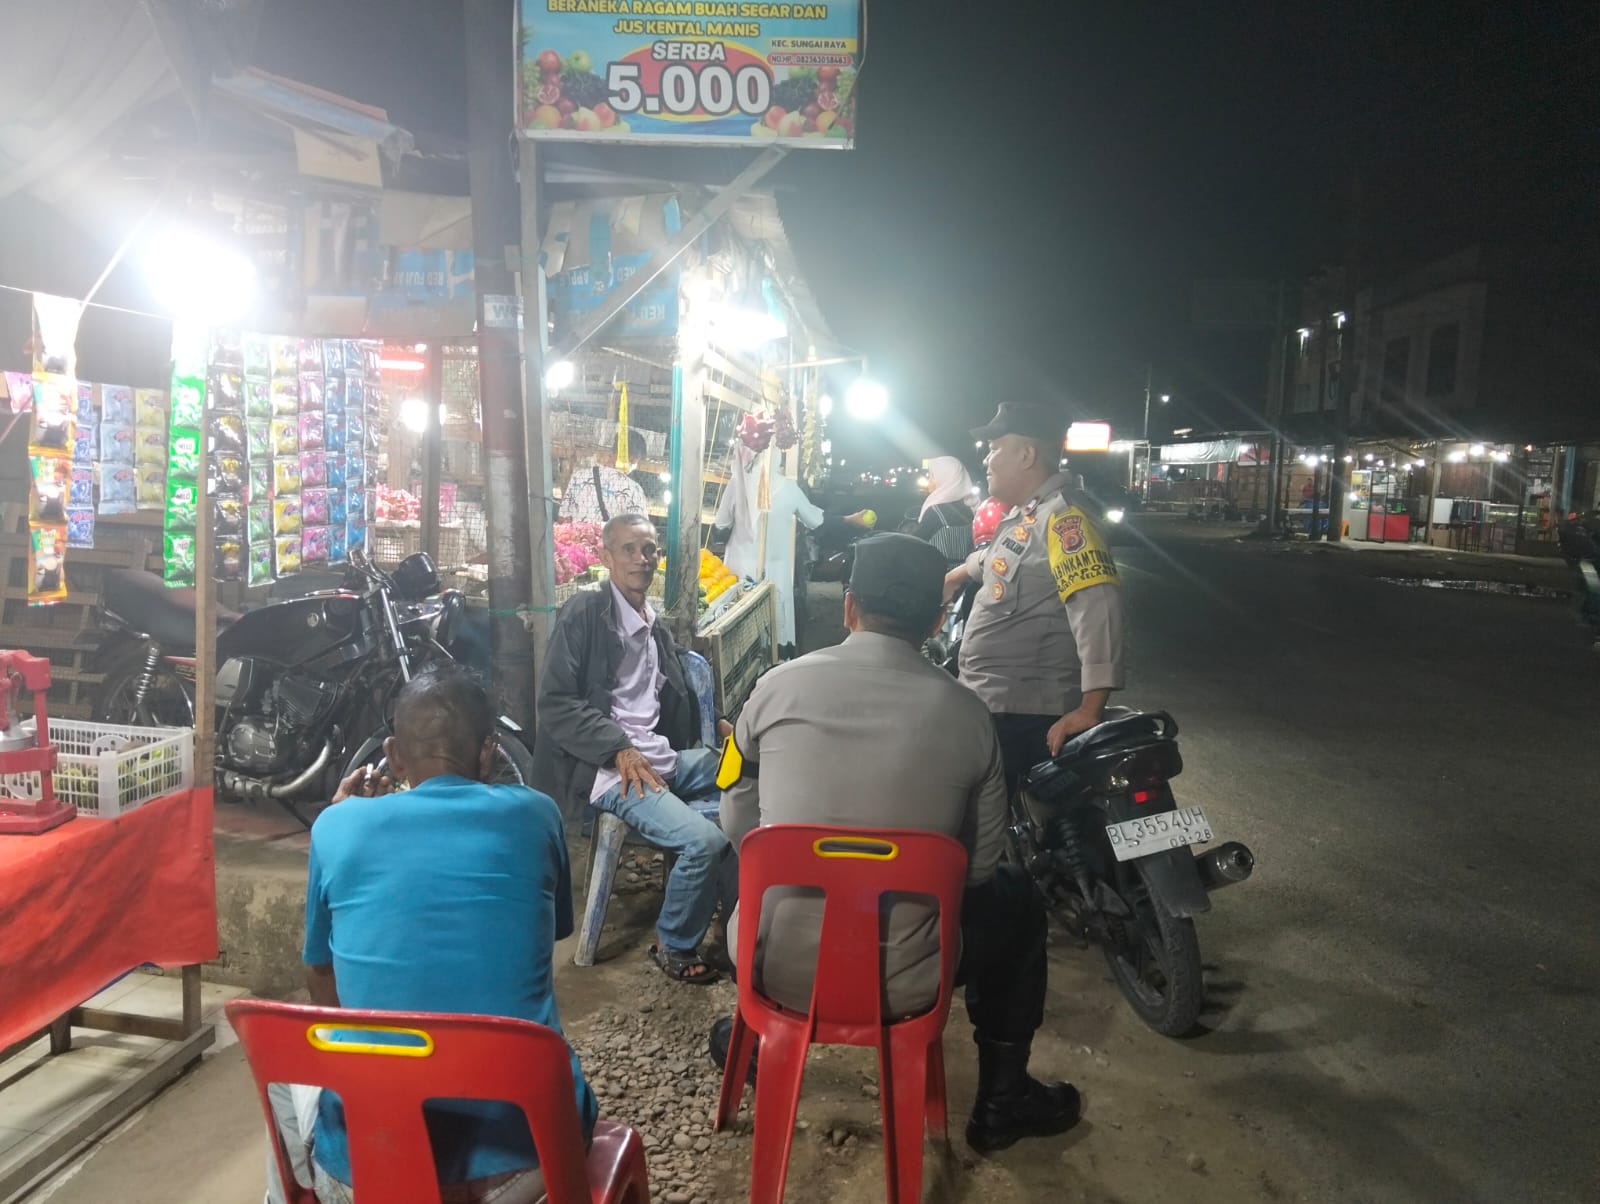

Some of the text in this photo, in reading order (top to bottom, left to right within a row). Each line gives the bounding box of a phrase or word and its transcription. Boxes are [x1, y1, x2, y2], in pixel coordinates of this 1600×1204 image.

[548, 0, 828, 19] BERANEKA RAGAM BUAH SEGAR DAN
[614, 20, 761, 37] JUS KENTAL MANIS
[652, 40, 727, 62] SERBA
[790, 40, 823, 49] SUNGAI
[824, 41, 847, 49] RAYA
[607, 63, 771, 115] 5.000
